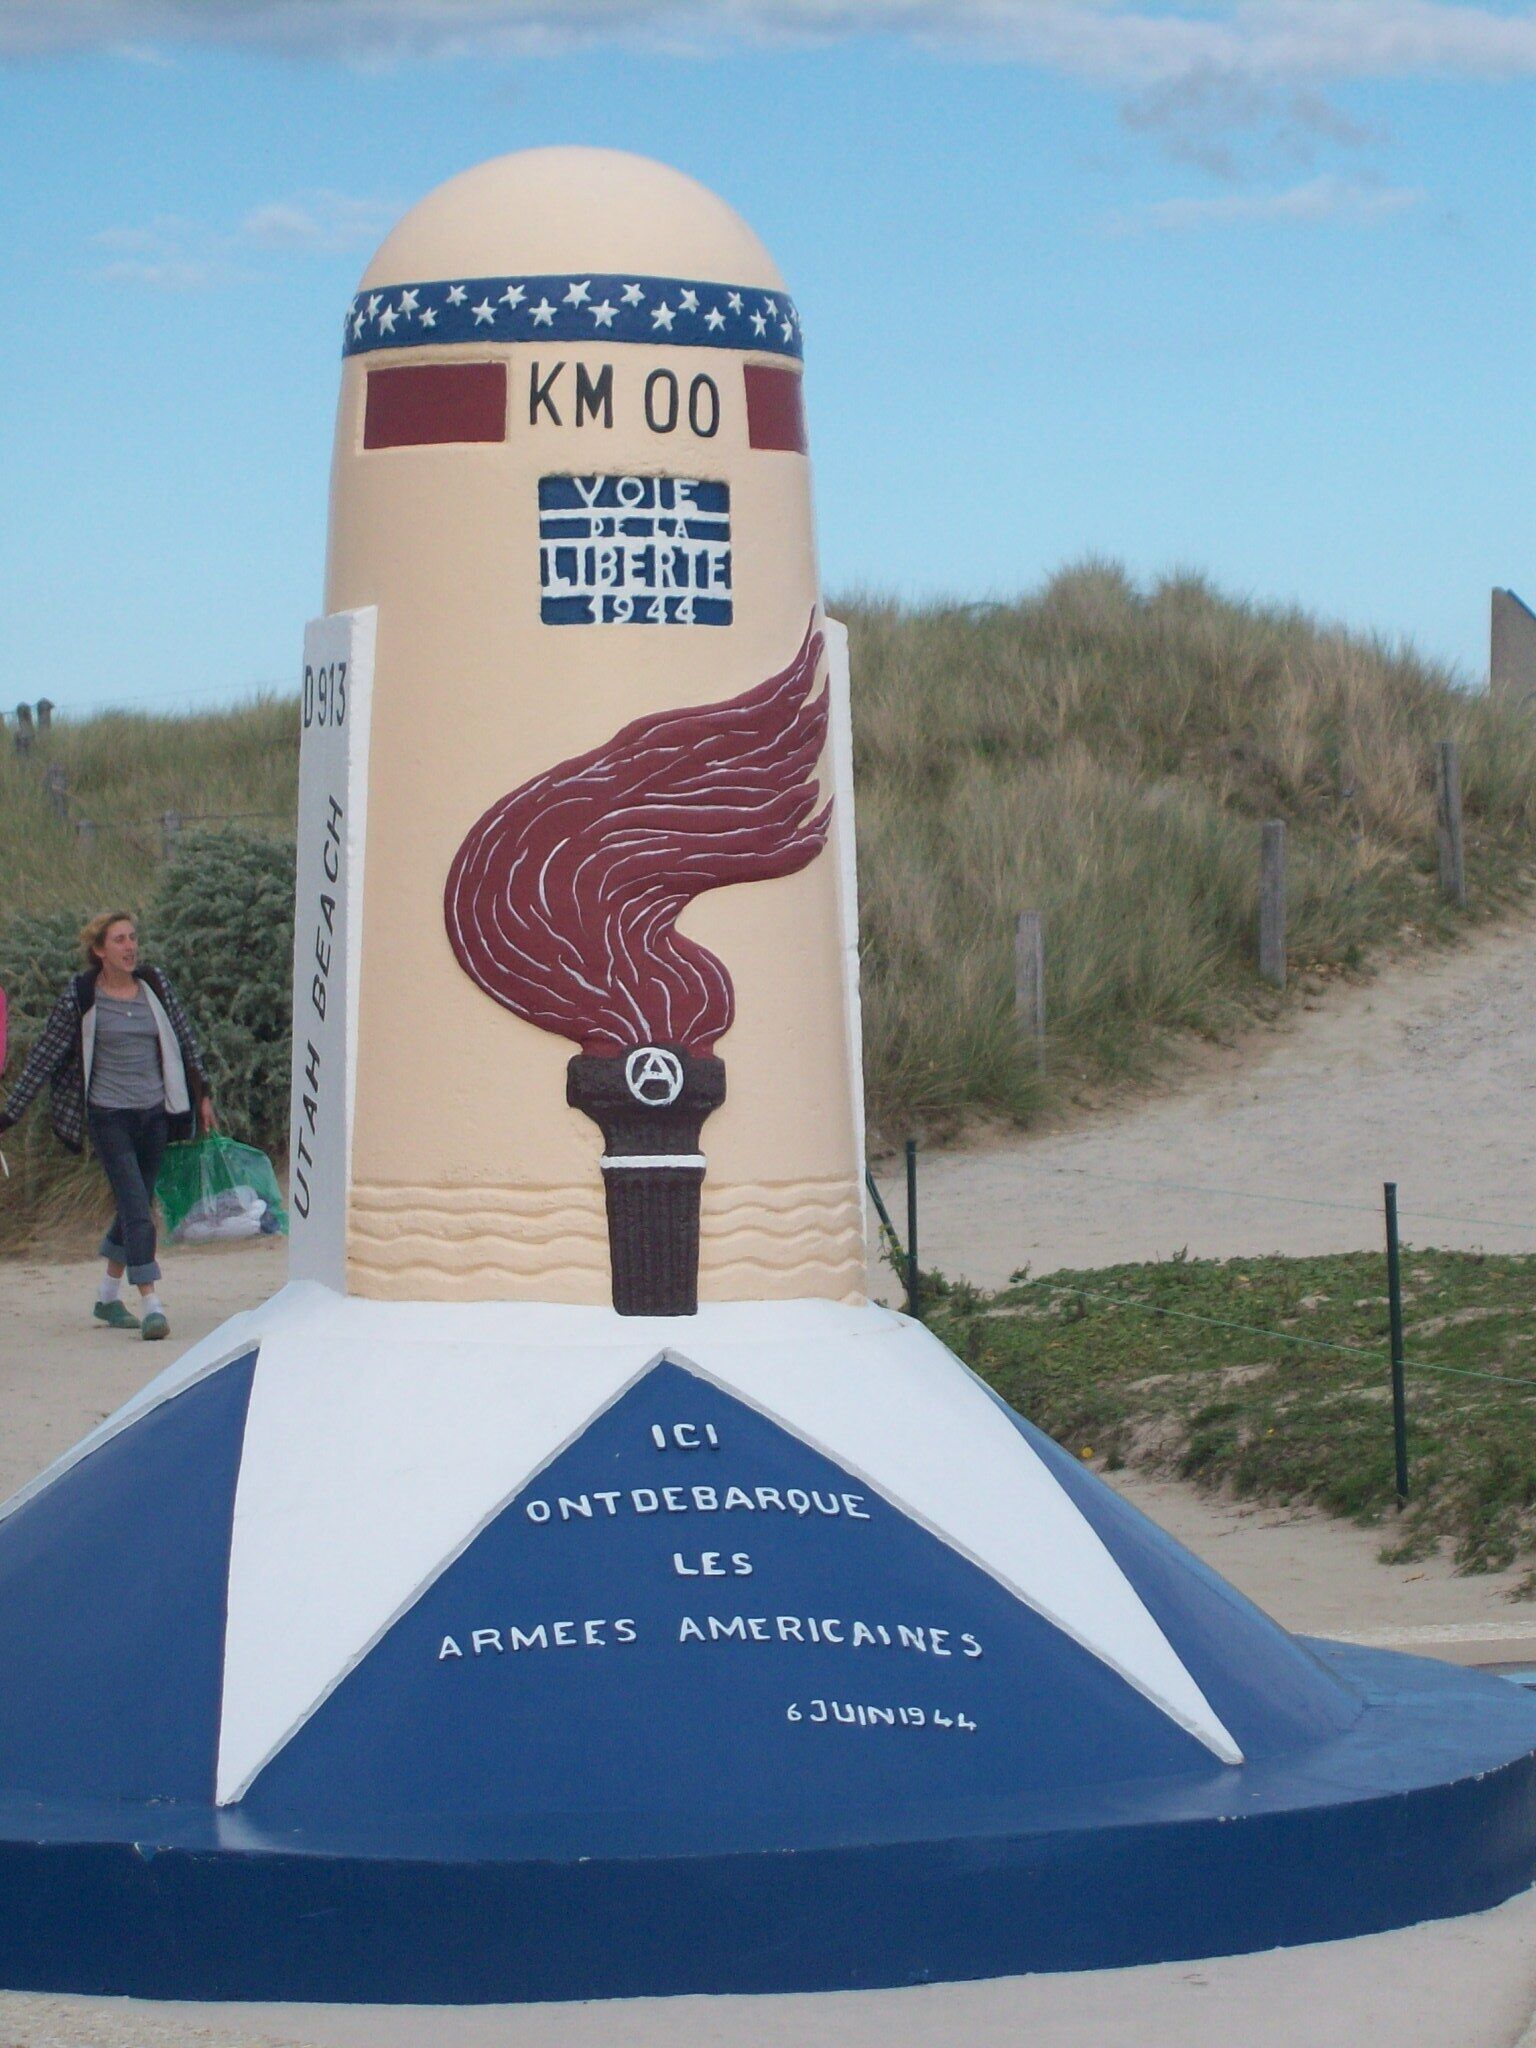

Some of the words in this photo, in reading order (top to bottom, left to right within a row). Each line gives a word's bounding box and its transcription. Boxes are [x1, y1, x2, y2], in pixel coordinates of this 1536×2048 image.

[530, 361, 613, 429] KM
[573, 477, 699, 510] VOIE
[592, 518, 627, 537] DE
[654, 519, 688, 538] LA
[545, 545, 731, 589] LIBERTE
[588, 595, 696, 624] 1944
[293, 1040, 321, 1219] UTAH
[311, 795, 343, 1023] BEACH
[652, 1423, 719, 1449] ICI
[674, 1553, 753, 1575] LES
[438, 1618, 637, 1659] ARMEES
[679, 1616, 982, 1658] AMERICAINES
[787, 1703, 803, 1722] 6
